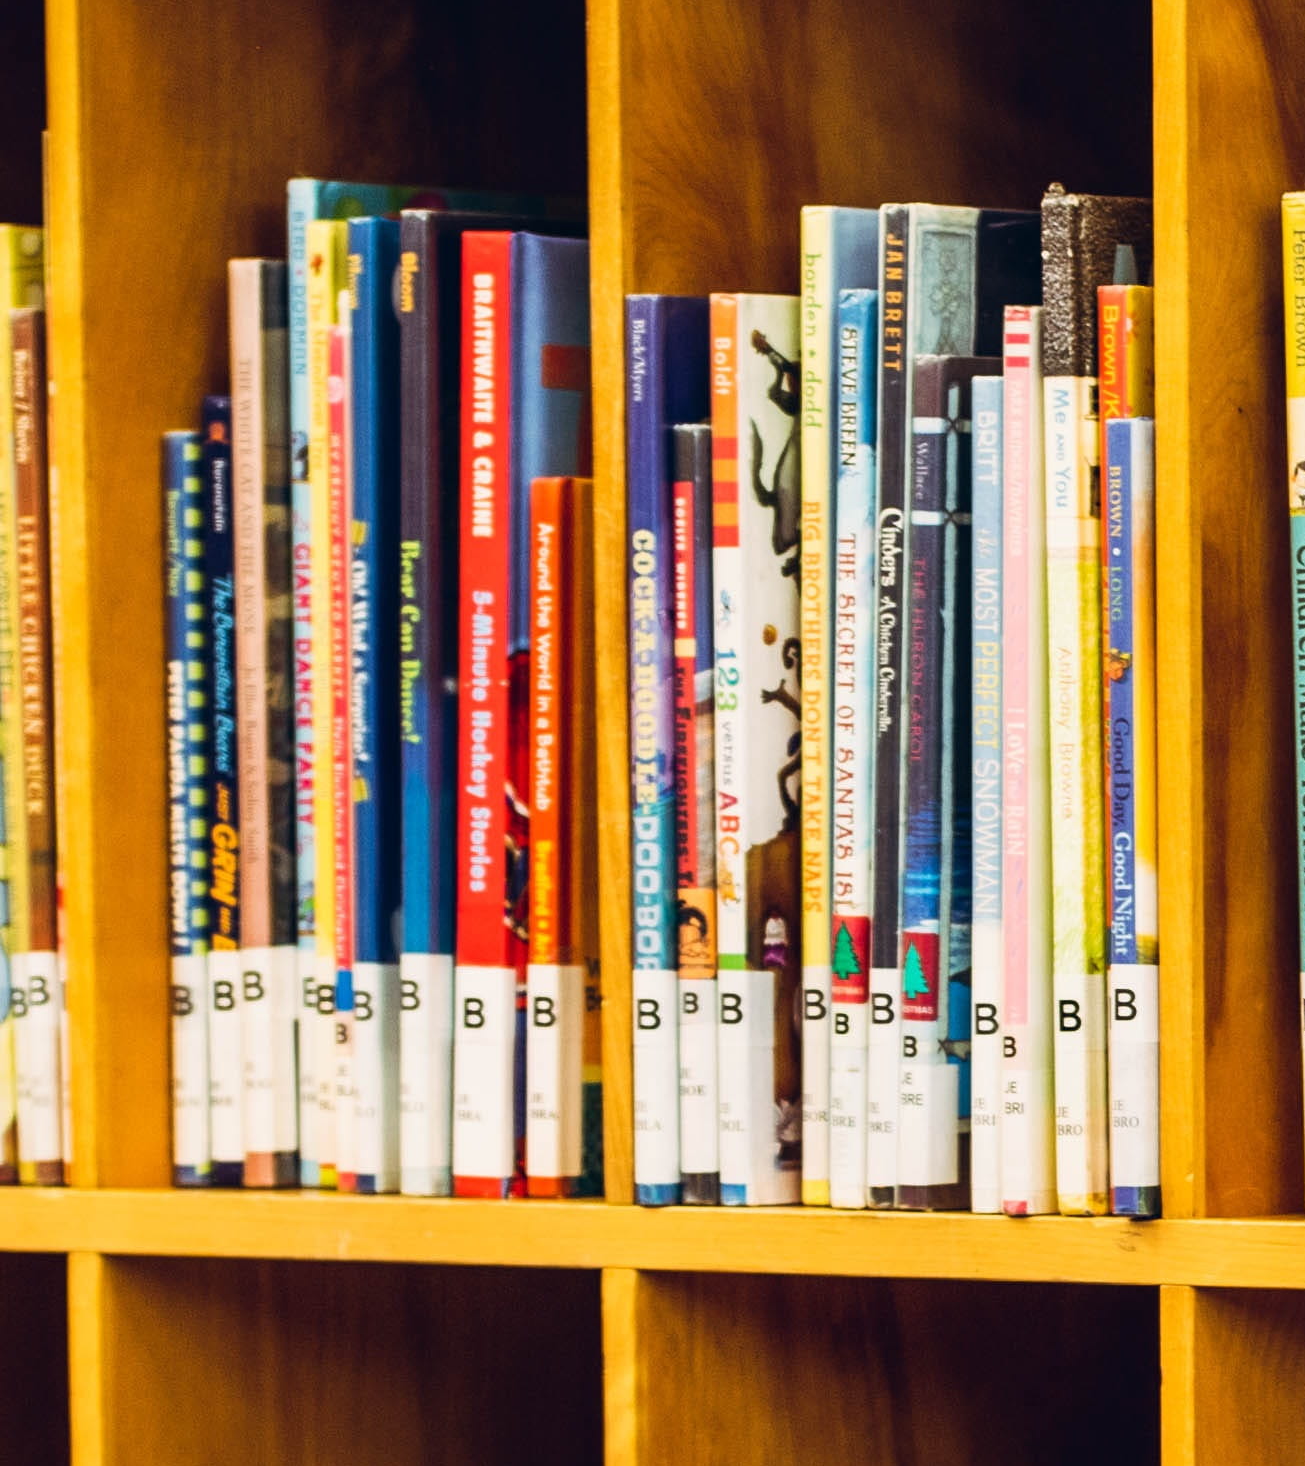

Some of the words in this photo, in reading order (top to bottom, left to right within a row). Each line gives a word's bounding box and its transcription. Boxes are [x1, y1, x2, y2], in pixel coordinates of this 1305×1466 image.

[884, 233, 905, 282] JAN
[472, 273, 495, 425] BRAITHWAITE
[714, 337, 732, 397] Boldt
[839, 326, 858, 389] STEVE
[881, 292, 901, 373] BRETT
[473, 433, 492, 448] &
[839, 396, 858, 468] BREEN
[472, 457, 495, 538] CRAINE
[466, 711, 495, 799] Hockey
[469, 808, 497, 893] Stories
[717, 792, 740, 856] ABC
[974, 758, 999, 915] SNOWMAN
[1059, 999, 1082, 1032] B
